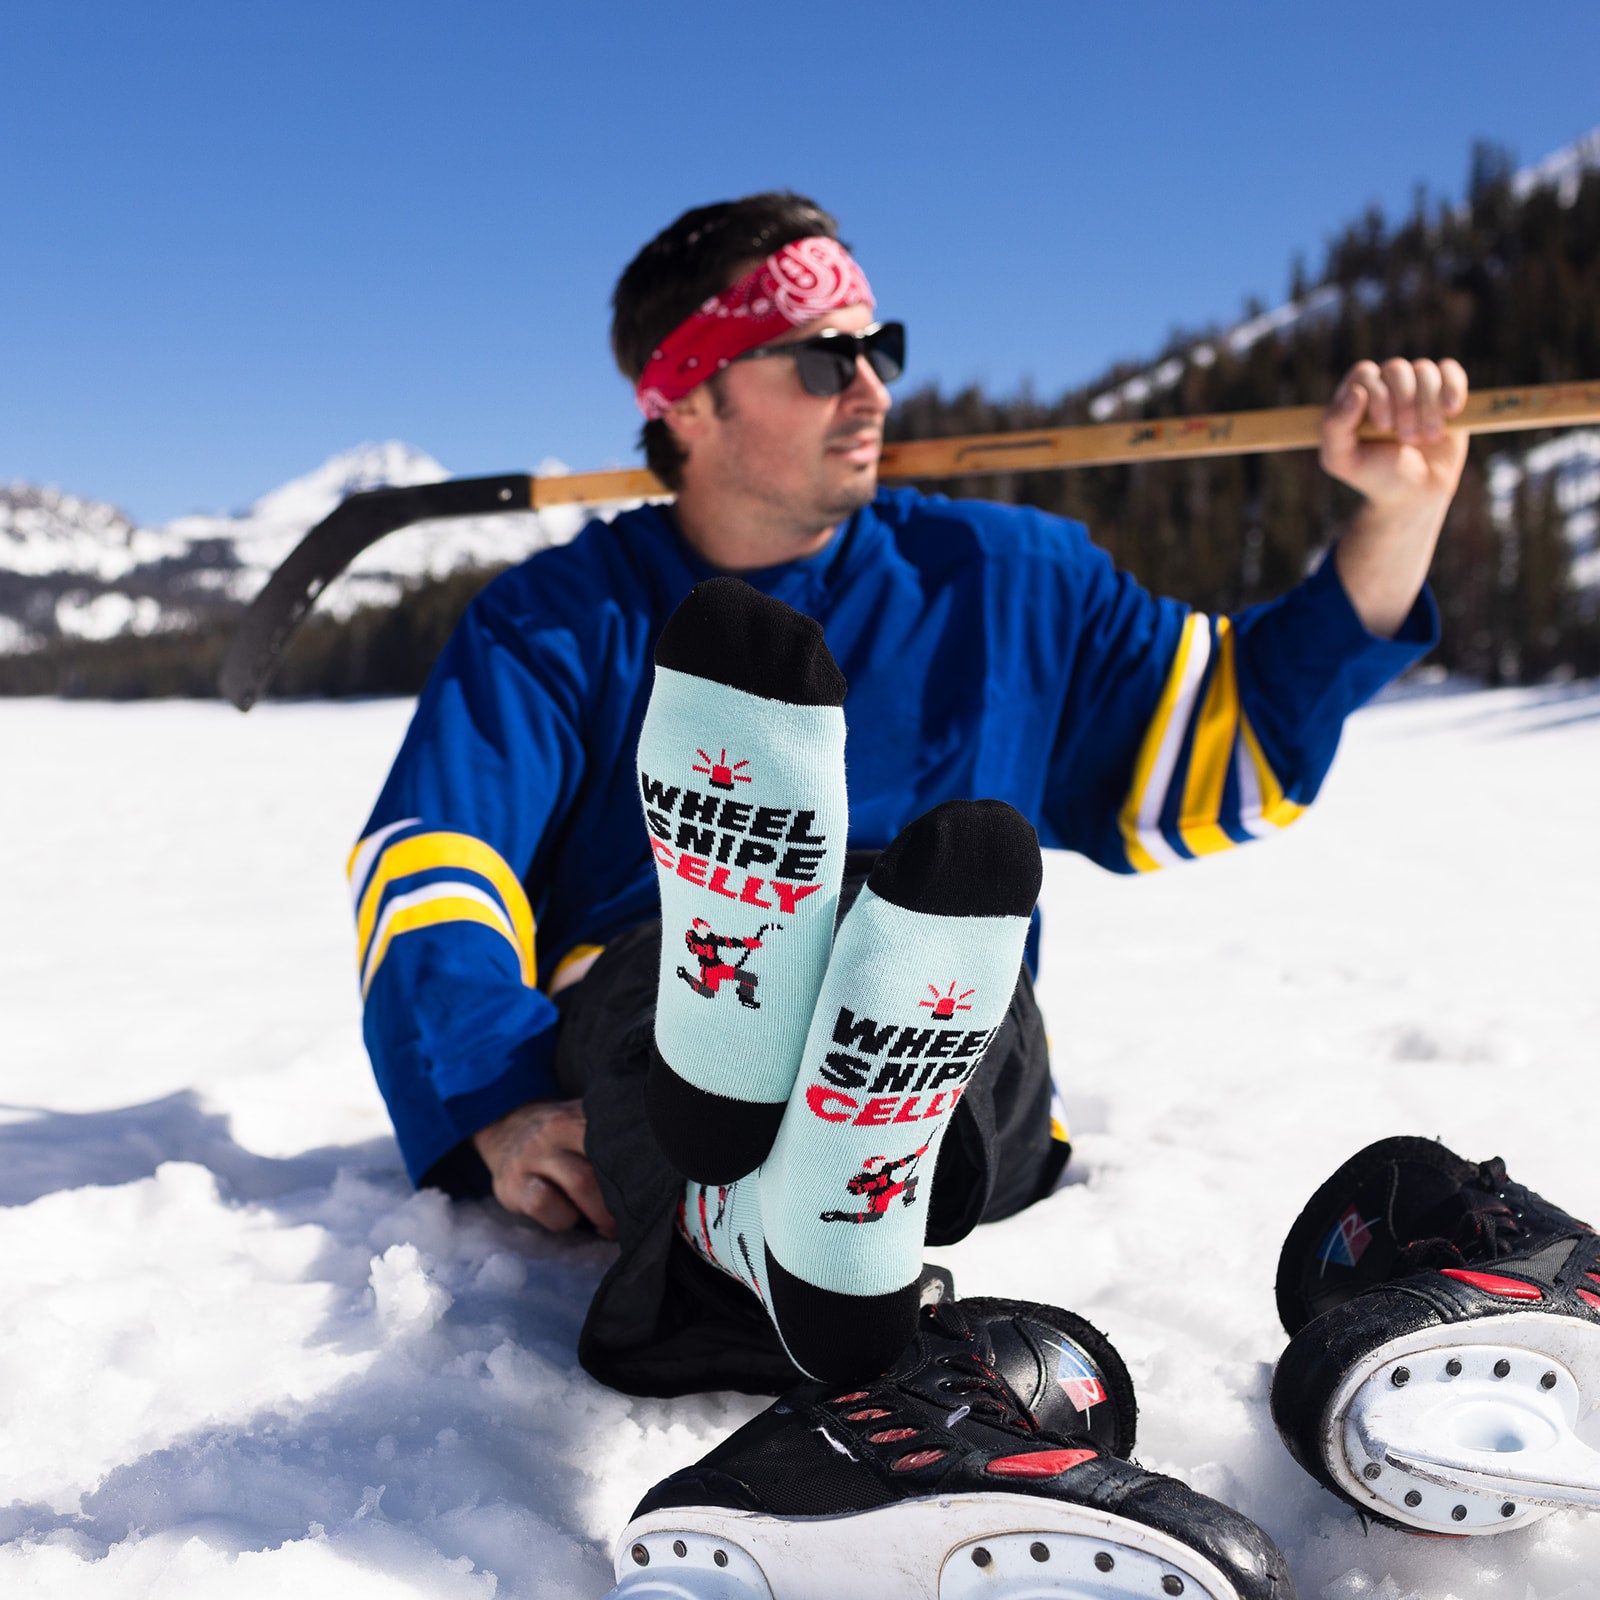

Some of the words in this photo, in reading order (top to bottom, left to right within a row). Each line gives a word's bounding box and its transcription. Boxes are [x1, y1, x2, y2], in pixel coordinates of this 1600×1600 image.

[642, 772, 825, 845] WHEEL
[648, 809, 826, 881] SNIPE
[650, 834, 823, 914] CELLY
